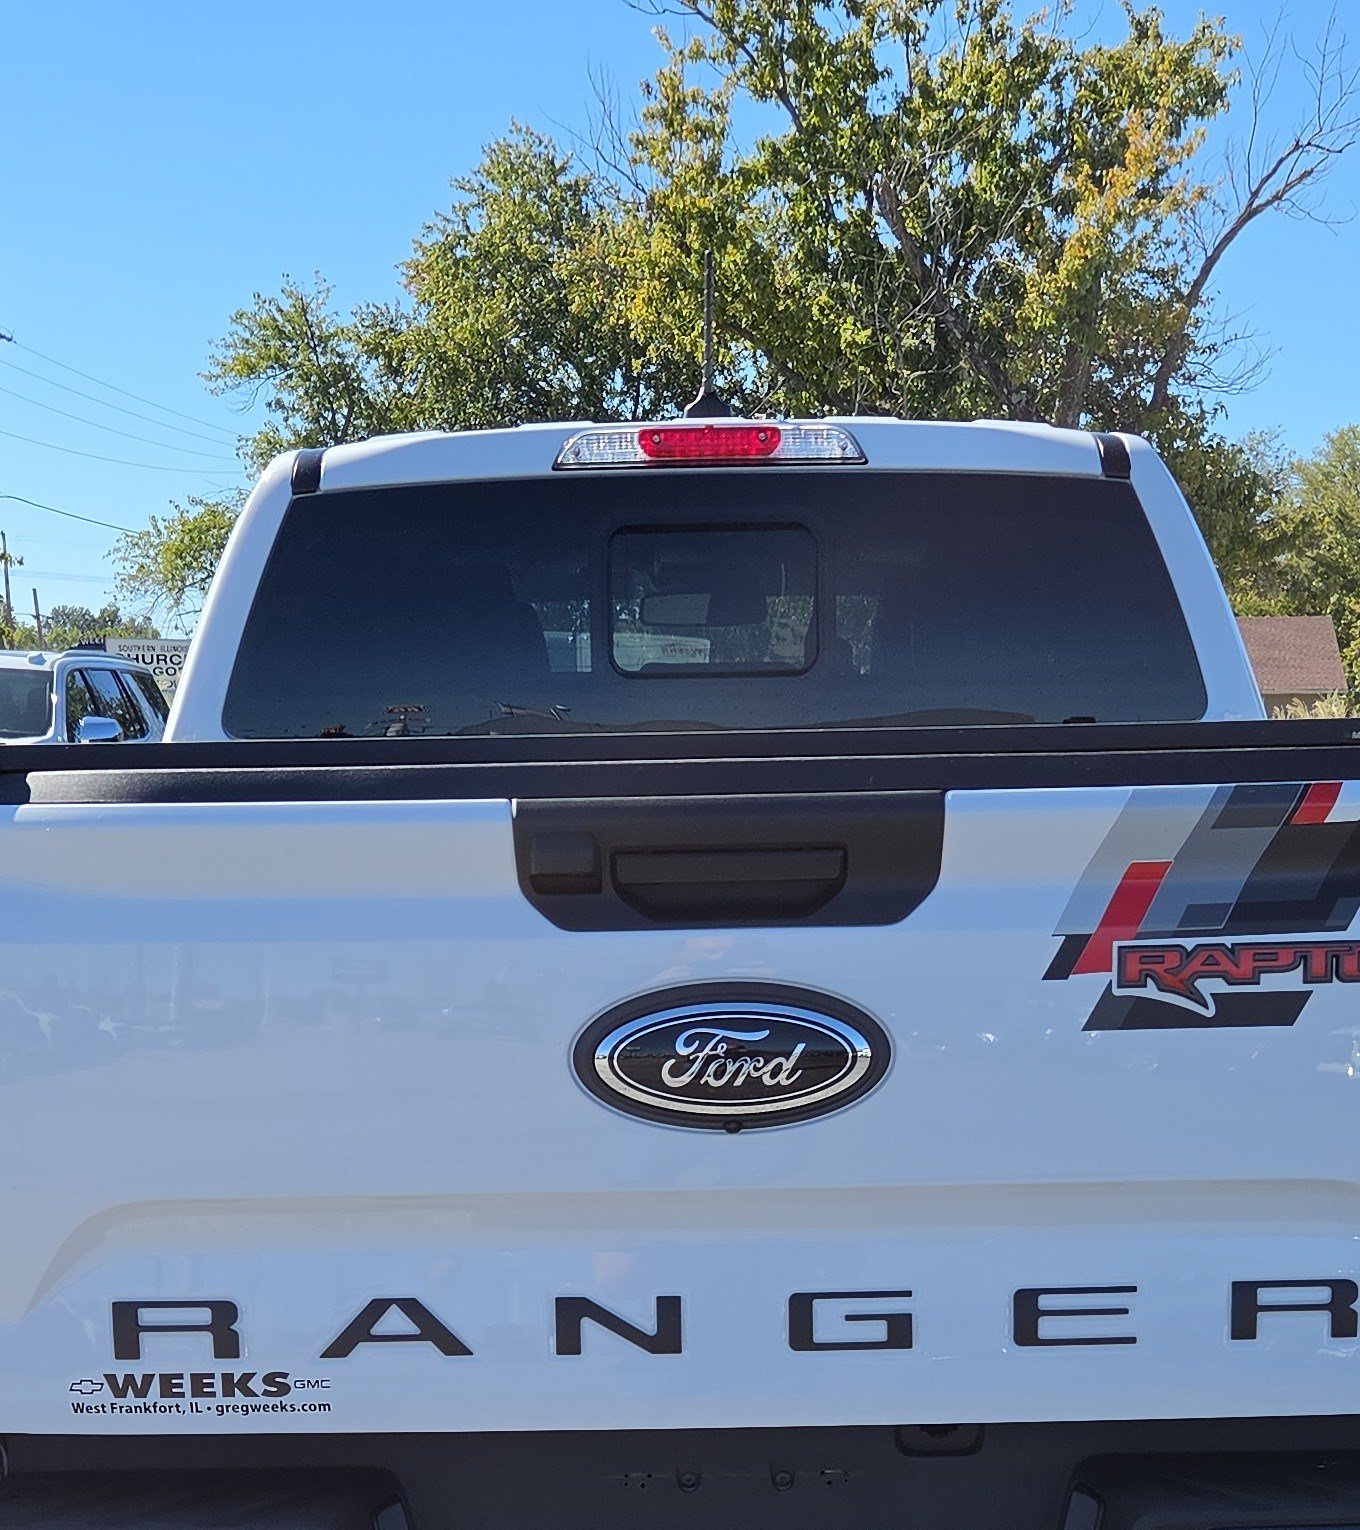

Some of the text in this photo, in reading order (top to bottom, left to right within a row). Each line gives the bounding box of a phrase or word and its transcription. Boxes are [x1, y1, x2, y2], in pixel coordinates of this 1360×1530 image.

[118, 644, 156, 653] SOUTHERN
[116, 653, 187, 665] HURC
[153, 666, 183, 676] GO
[661, 1027, 807, 1088] Ford
[112, 1278, 1359, 1360] RANGER
[103, 1372, 332, 1398] WEEKS GMC
[71, 1400, 332, 1416] West Frankfort, IL gregweeks.com
